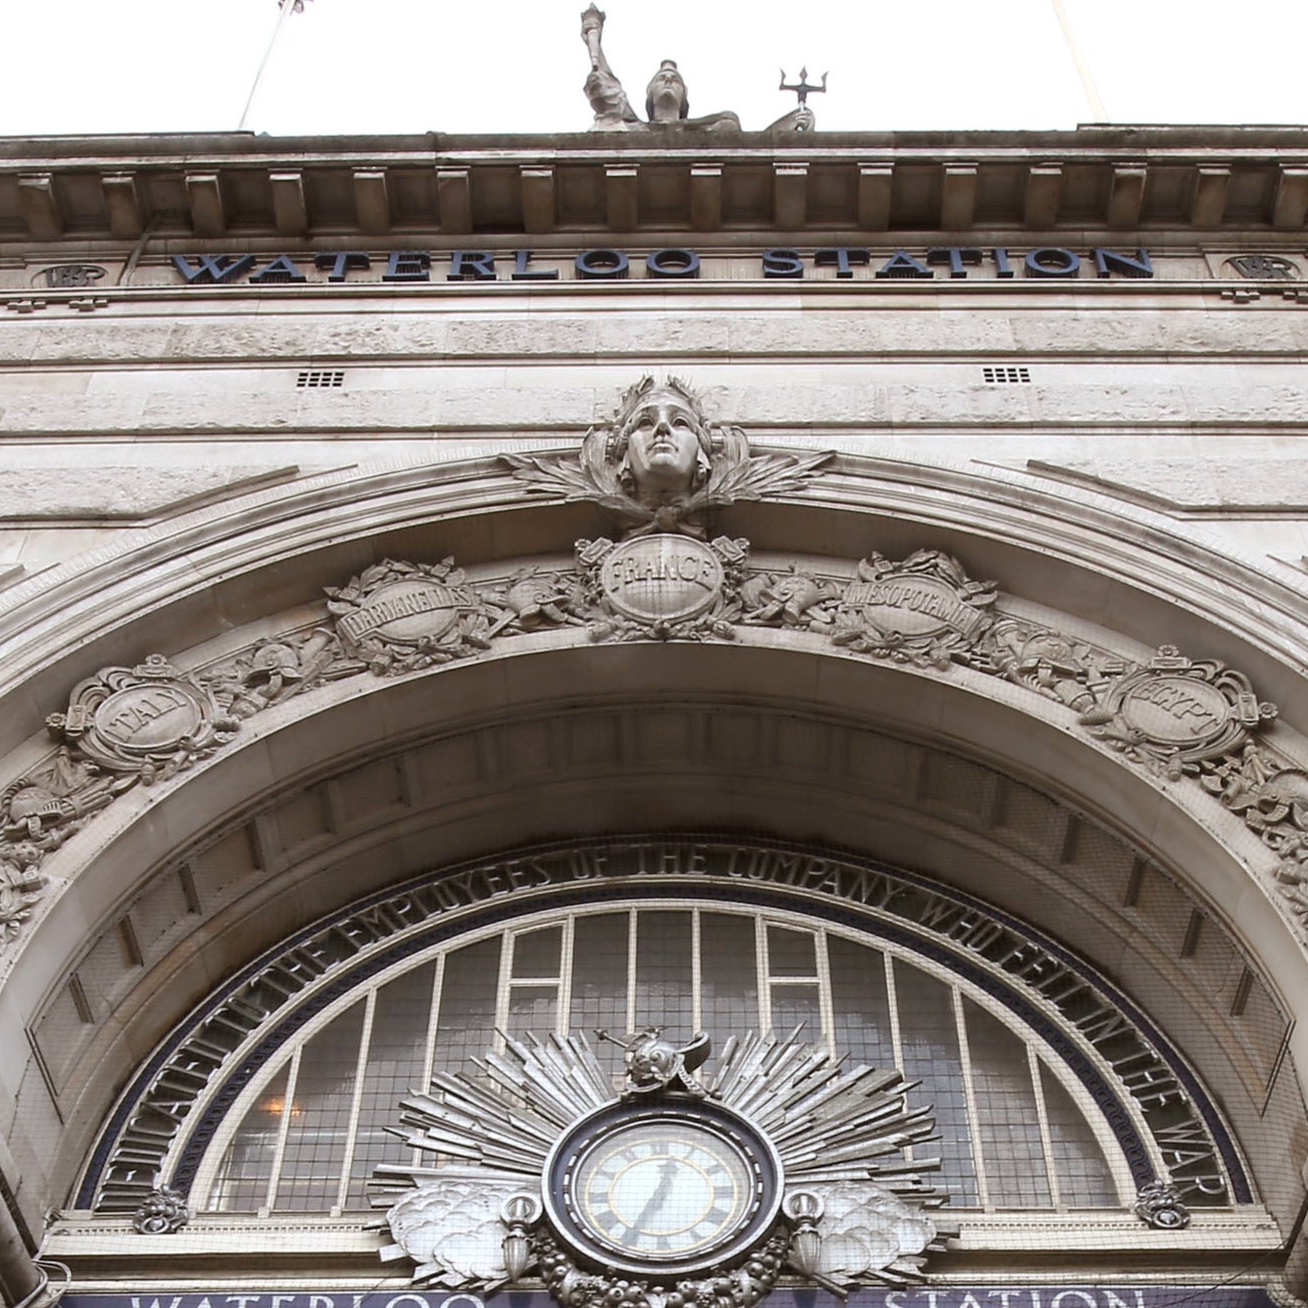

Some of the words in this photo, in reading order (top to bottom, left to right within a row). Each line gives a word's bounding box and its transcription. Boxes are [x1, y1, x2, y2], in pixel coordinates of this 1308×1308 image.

[171, 248, 701, 285] WATERLOO
[762, 247, 1155, 280] STATION
[611, 555, 715, 593] FRANCE
[345, 587, 472, 635] DARDANELLES
[850, 582, 979, 629] MESOPOTAMIA
[102, 689, 188, 742] ITALY
[1129, 681, 1221, 735] EGYPT
[204, 995, 272, 1038] TO
[250, 939, 342, 999] THE
[336, 859, 552, 950] EMPLOYEES
[570, 846, 610, 879] OF
[629, 844, 708, 875] THE
[728, 848, 909, 911] COMPANY
[919, 892, 1004, 952] WHO
[995, 942, 1092, 1010] FELL
[1068, 1005, 1137, 1044] IN
[1108, 1040, 1189, 1112] THE
[1154, 1118, 1228, 1195] WAR
